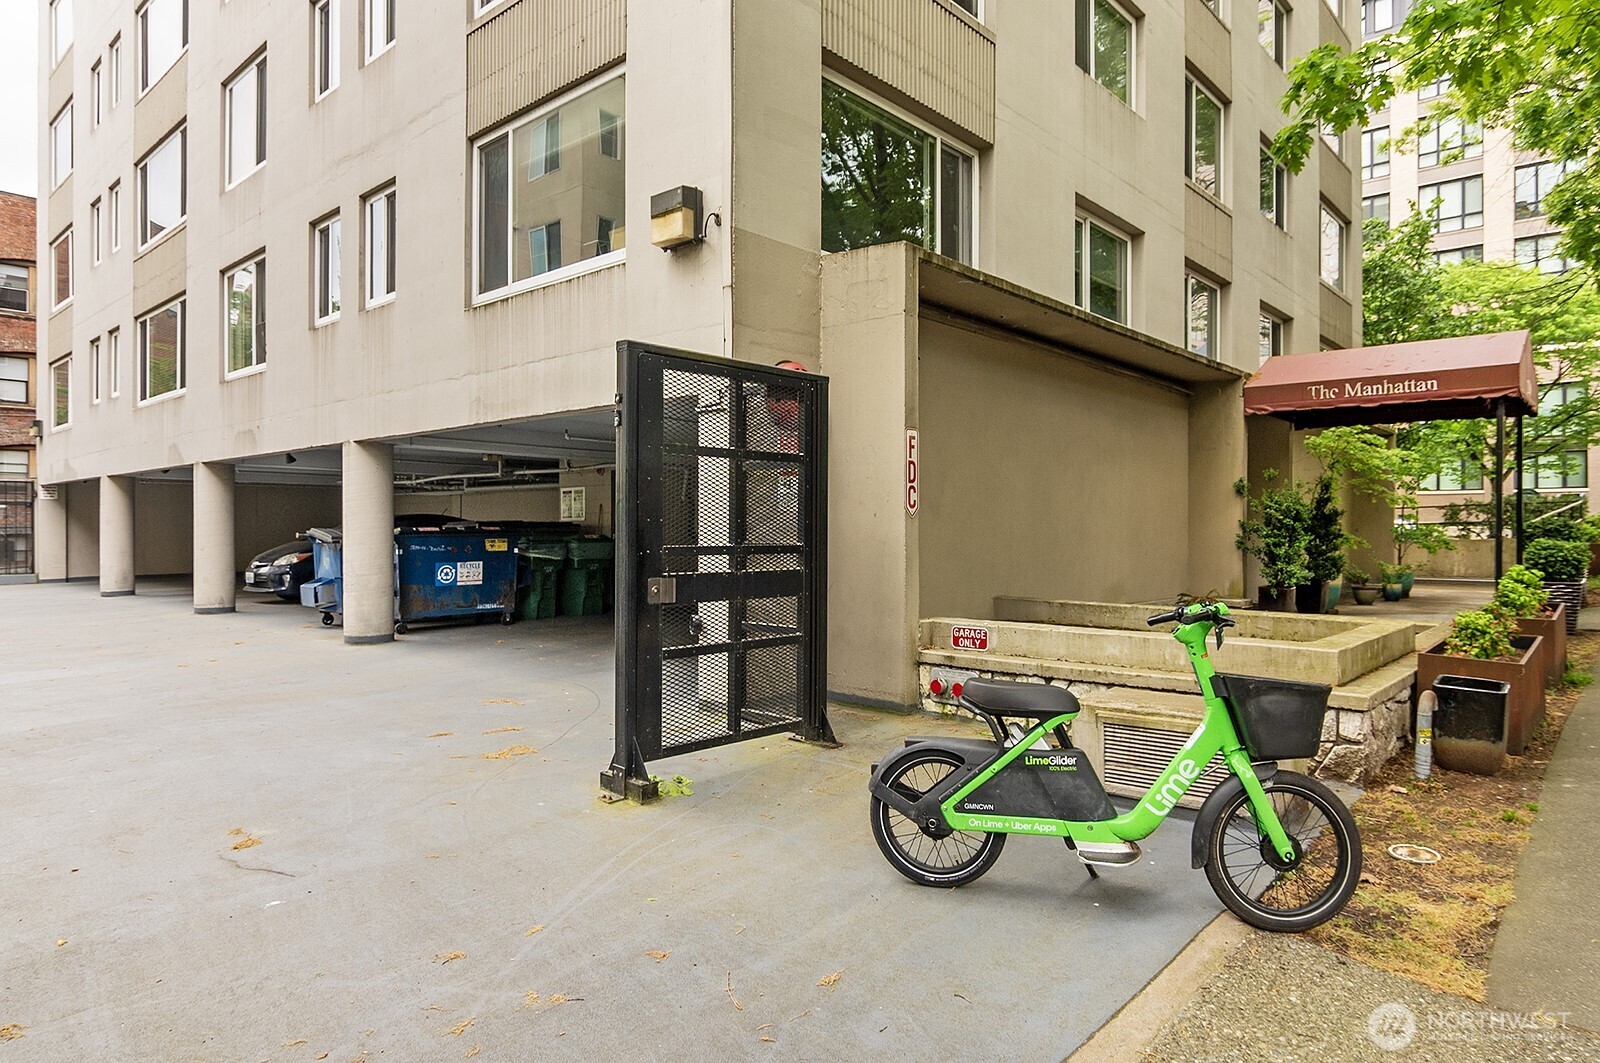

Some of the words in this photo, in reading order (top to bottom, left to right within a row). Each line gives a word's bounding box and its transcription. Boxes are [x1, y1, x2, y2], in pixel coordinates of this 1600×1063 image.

[1307, 385, 1339, 400] The
[1344, 379, 1438, 397] Manhattan
[908, 435, 917, 509] FDC
[953, 628, 986, 640] GARAGE
[958, 637, 981, 648] ONLY
[1025, 755, 1077, 766] LimeGlider
[1144, 759, 1200, 816] Lime
[968, 818, 981, 827] On
[982, 819, 1003, 829] Lime
[1011, 821, 1032, 831] Uber
[1033, 823, 1057, 833] Apps
